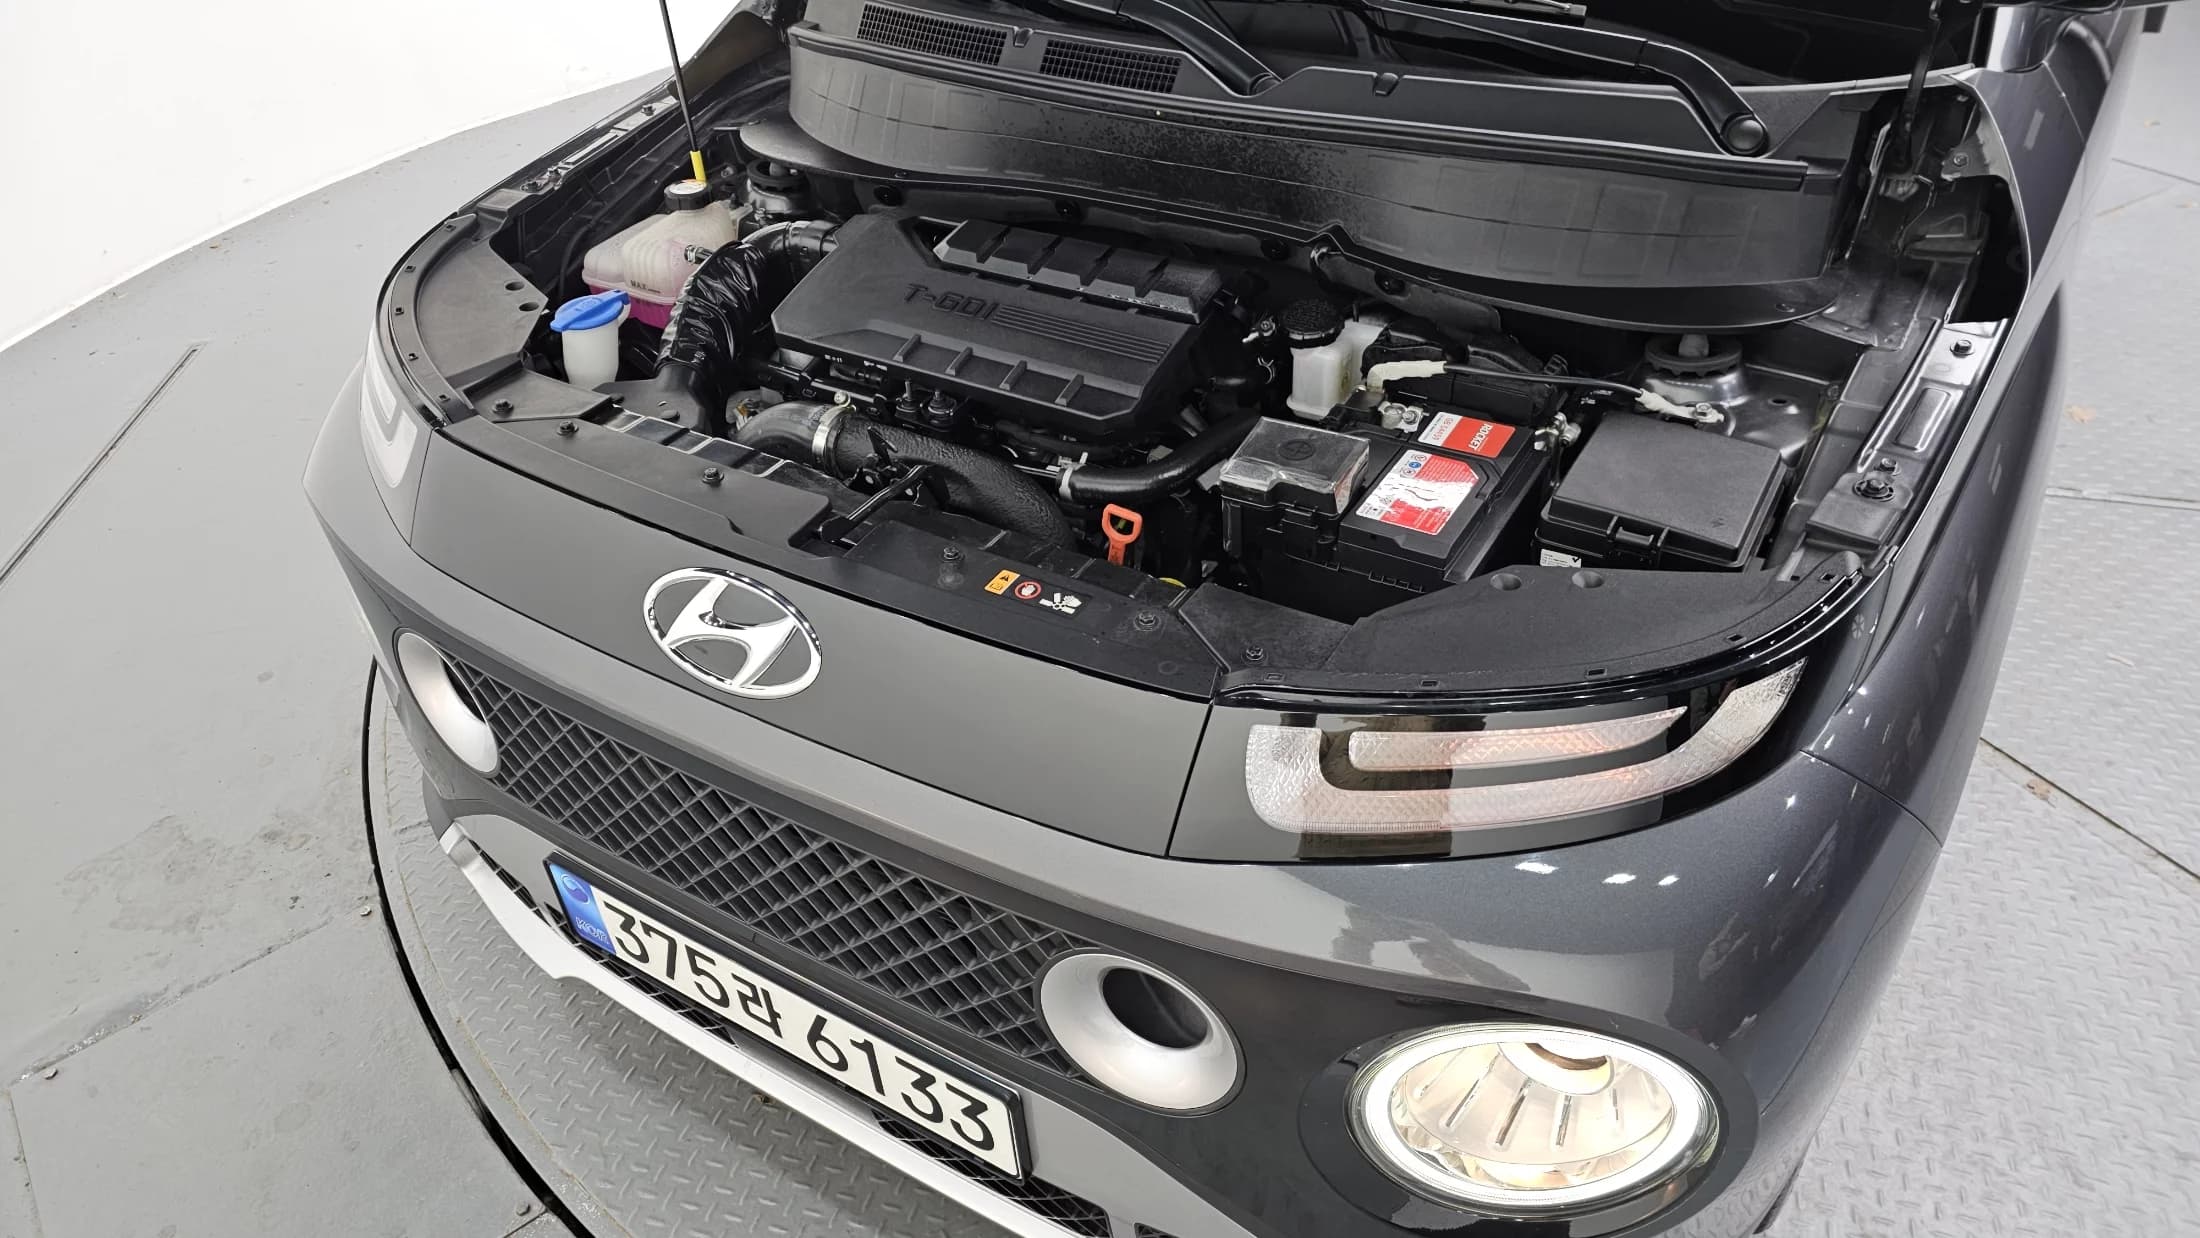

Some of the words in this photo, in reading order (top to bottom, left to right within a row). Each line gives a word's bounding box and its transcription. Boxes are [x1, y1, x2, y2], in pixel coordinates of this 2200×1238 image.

[905, 283, 1000, 321] T-GDI
[1468, 423, 1494, 451] ROCKET
[603, 900, 784, 1039] 375라
[806, 1014, 995, 1151] 6133
